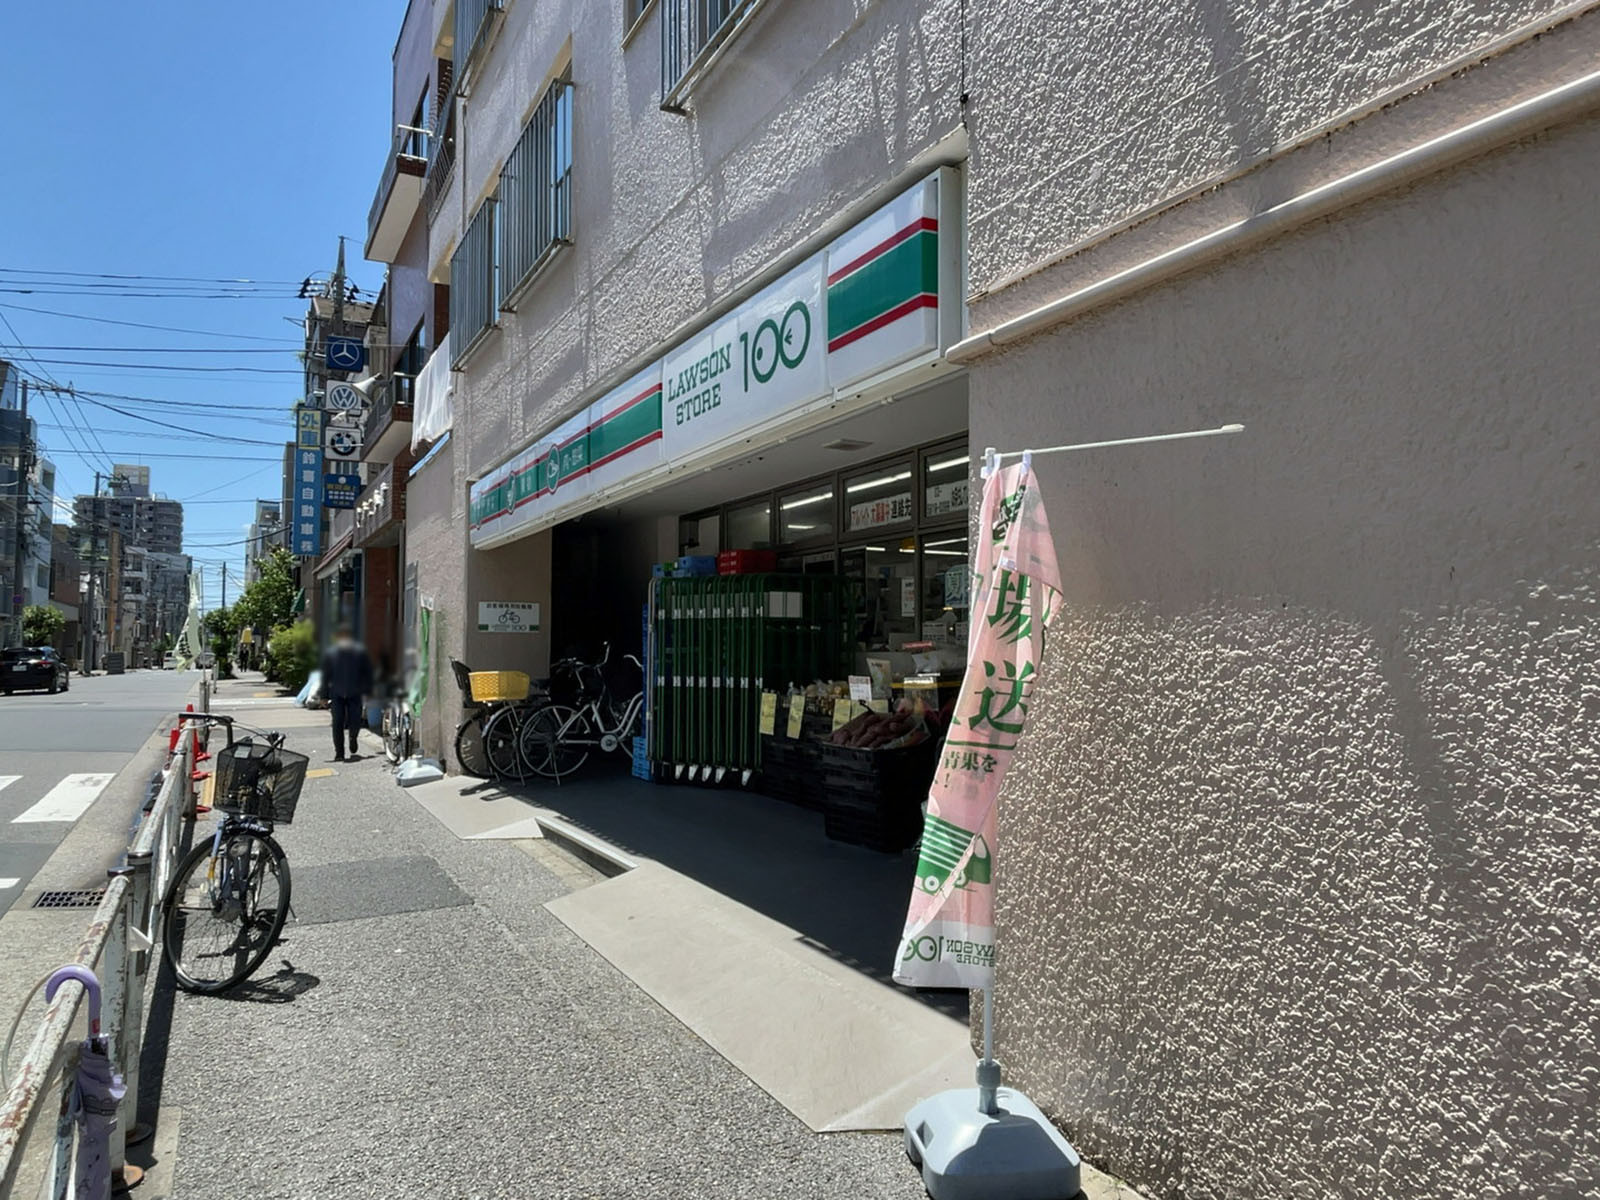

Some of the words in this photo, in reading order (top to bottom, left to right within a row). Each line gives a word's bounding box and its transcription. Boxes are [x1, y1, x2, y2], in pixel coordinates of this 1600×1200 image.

[668, 343, 731, 401] LAWSON
[740, 301, 811, 393] 100
[676, 383, 721, 425] STORE
